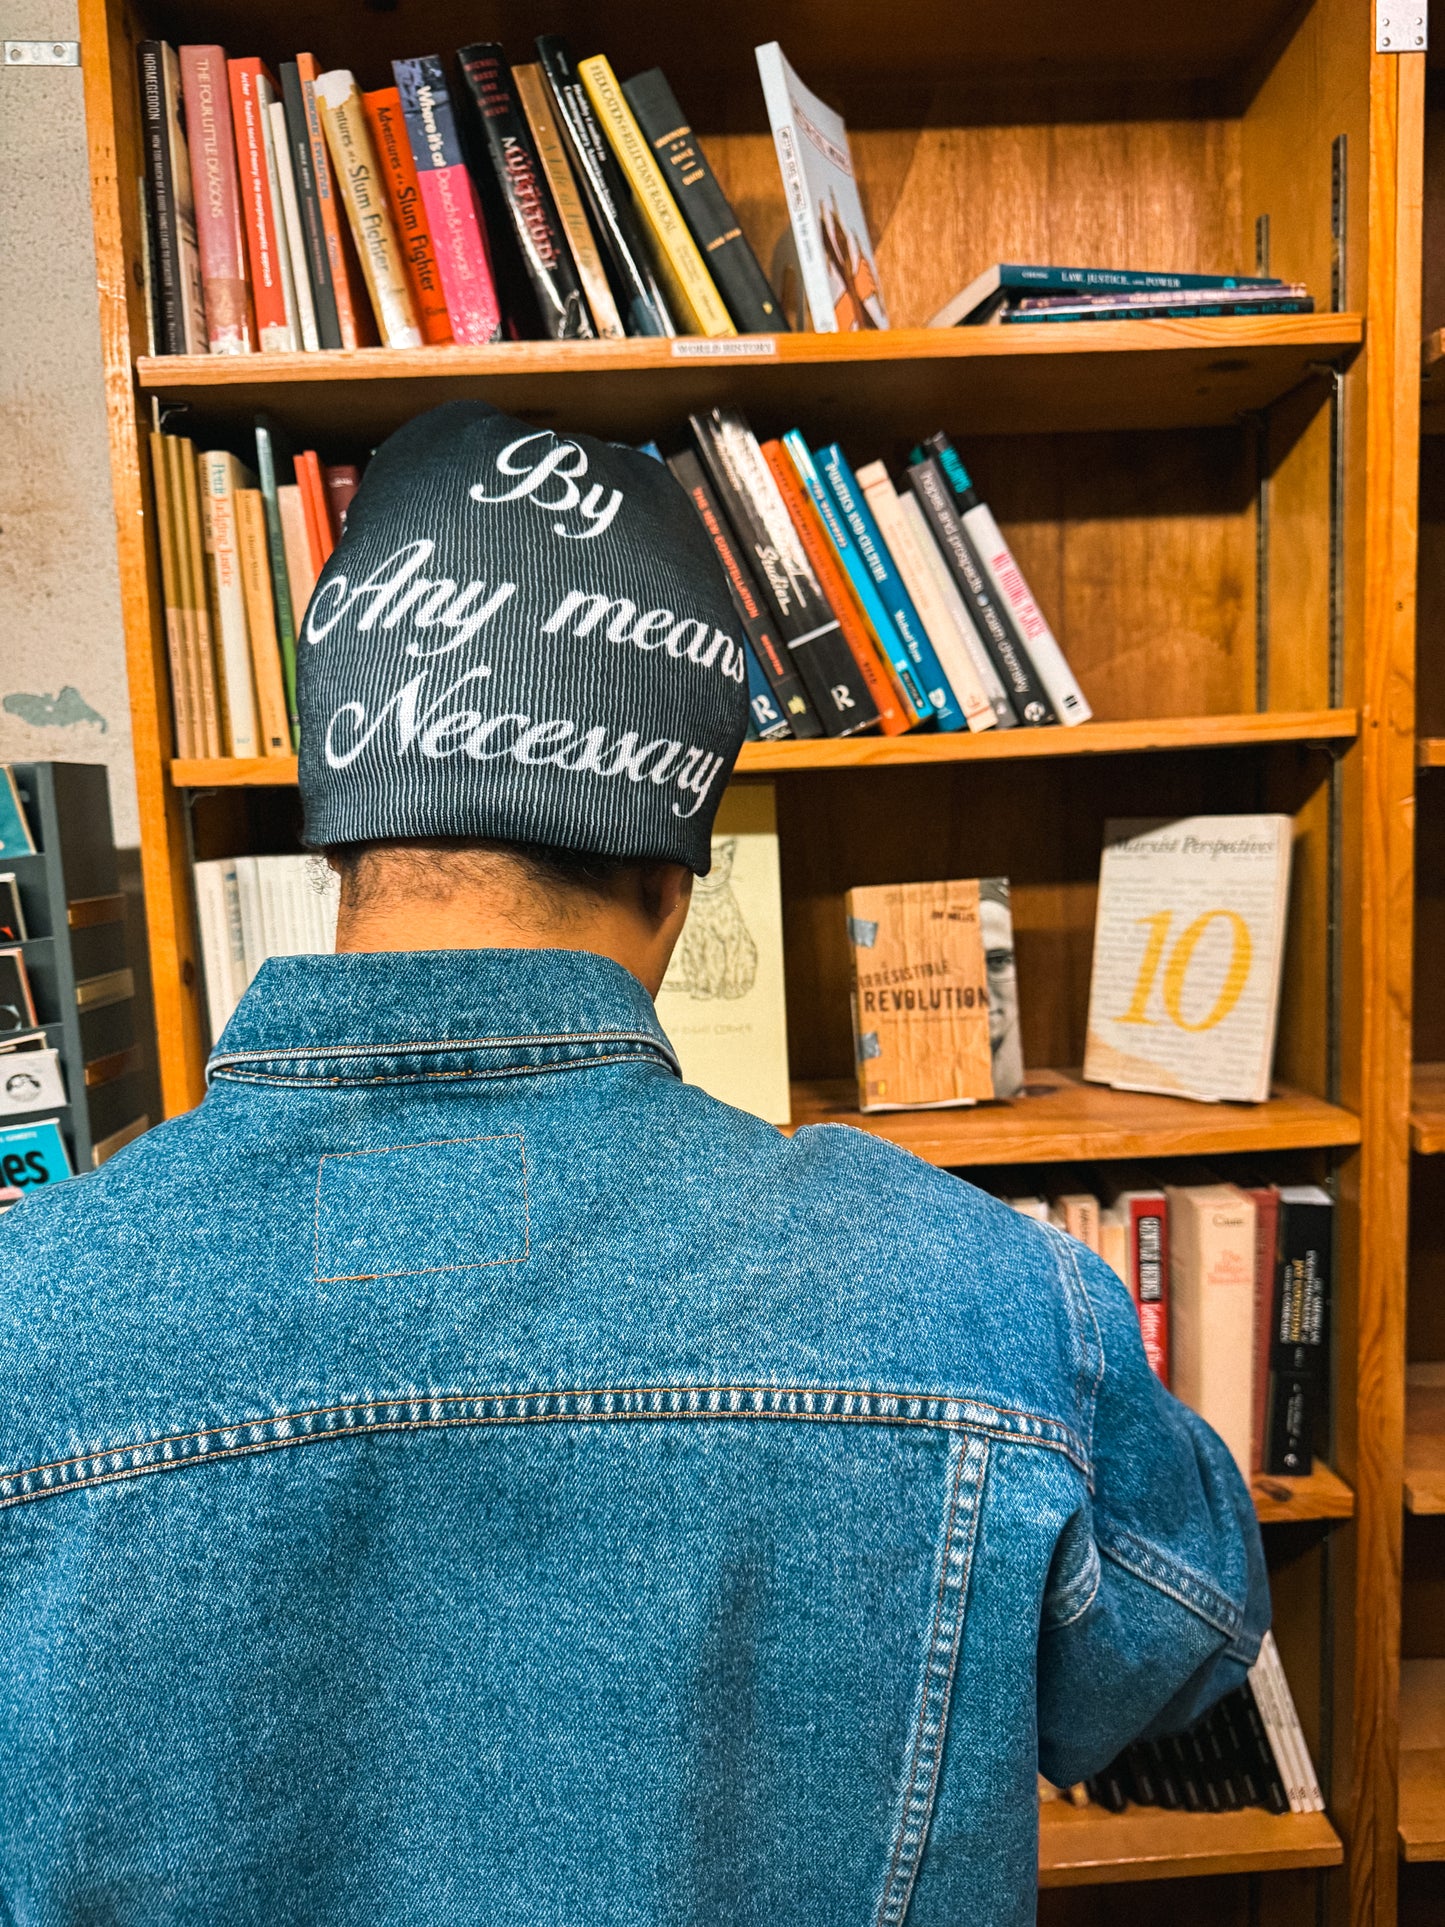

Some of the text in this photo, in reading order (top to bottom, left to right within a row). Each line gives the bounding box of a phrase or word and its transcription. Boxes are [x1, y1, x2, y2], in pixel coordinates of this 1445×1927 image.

[141, 52, 162, 120] HORMEGEDDON
[239, 71, 251, 96] Archer
[242, 99, 255, 126] Realist
[333, 105, 355, 147] ntures
[560, 84, 592, 148] Contemporary
[569, 82, 608, 162] Healthy Conflict in
[196, 58, 223, 217] THE FOUR LITTLE DRAGONS
[245, 127, 257, 149] social
[375, 104, 405, 170] Adventures
[590, 68, 679, 233] EDUCATION RELUCTANT RADICAL
[252, 178, 262, 192] the
[312, 141, 330, 199] EVOLUTION
[348, 163, 377, 209] Slum
[414, 84, 475, 282] Where it's at Deutsch & Howard
[396, 185, 424, 230] Slum
[499, 133, 563, 272] MULTITUDE
[359, 212, 394, 275] Fighter
[404, 234, 440, 294] Fighter
[258, 250, 274, 287] approach
[1145, 275, 1181, 288] POWER
[678, 342, 771, 354] WORLD HISTORY
[469, 429, 624, 539] By
[823, 461, 857, 513] POLITICS
[915, 468, 949, 512] hopes
[210, 494, 234, 545] Judging
[845, 509, 867, 537] AND
[936, 507, 960, 535] and
[217, 547, 239, 587] Justice
[690, 486, 710, 510] THE
[700, 508, 722, 537] NEW
[712, 533, 761, 619] CONSTELLATION
[855, 532, 889, 584] CULTURE
[943, 530, 989, 595] prospects
[754, 542, 791, 617] Studies
[305, 538, 517, 658] Any
[540, 588, 747, 684] means
[978, 602, 1009, 642] noam
[1013, 601, 1049, 640] PLACE
[904, 638, 927, 664] Ryan
[993, 636, 1035, 695] chomsky
[752, 694, 779, 725] R
[830, 683, 857, 711] R
[324, 665, 724, 819] Necessary
[1112, 834, 1273, 861] Marxist Perspectives
[859, 960, 951, 988] IRRESISTIBLE
[1111, 908, 1254, 1033] 10
[864, 987, 989, 1013] REVOLUTION
[0, 1150, 50, 1188] es
